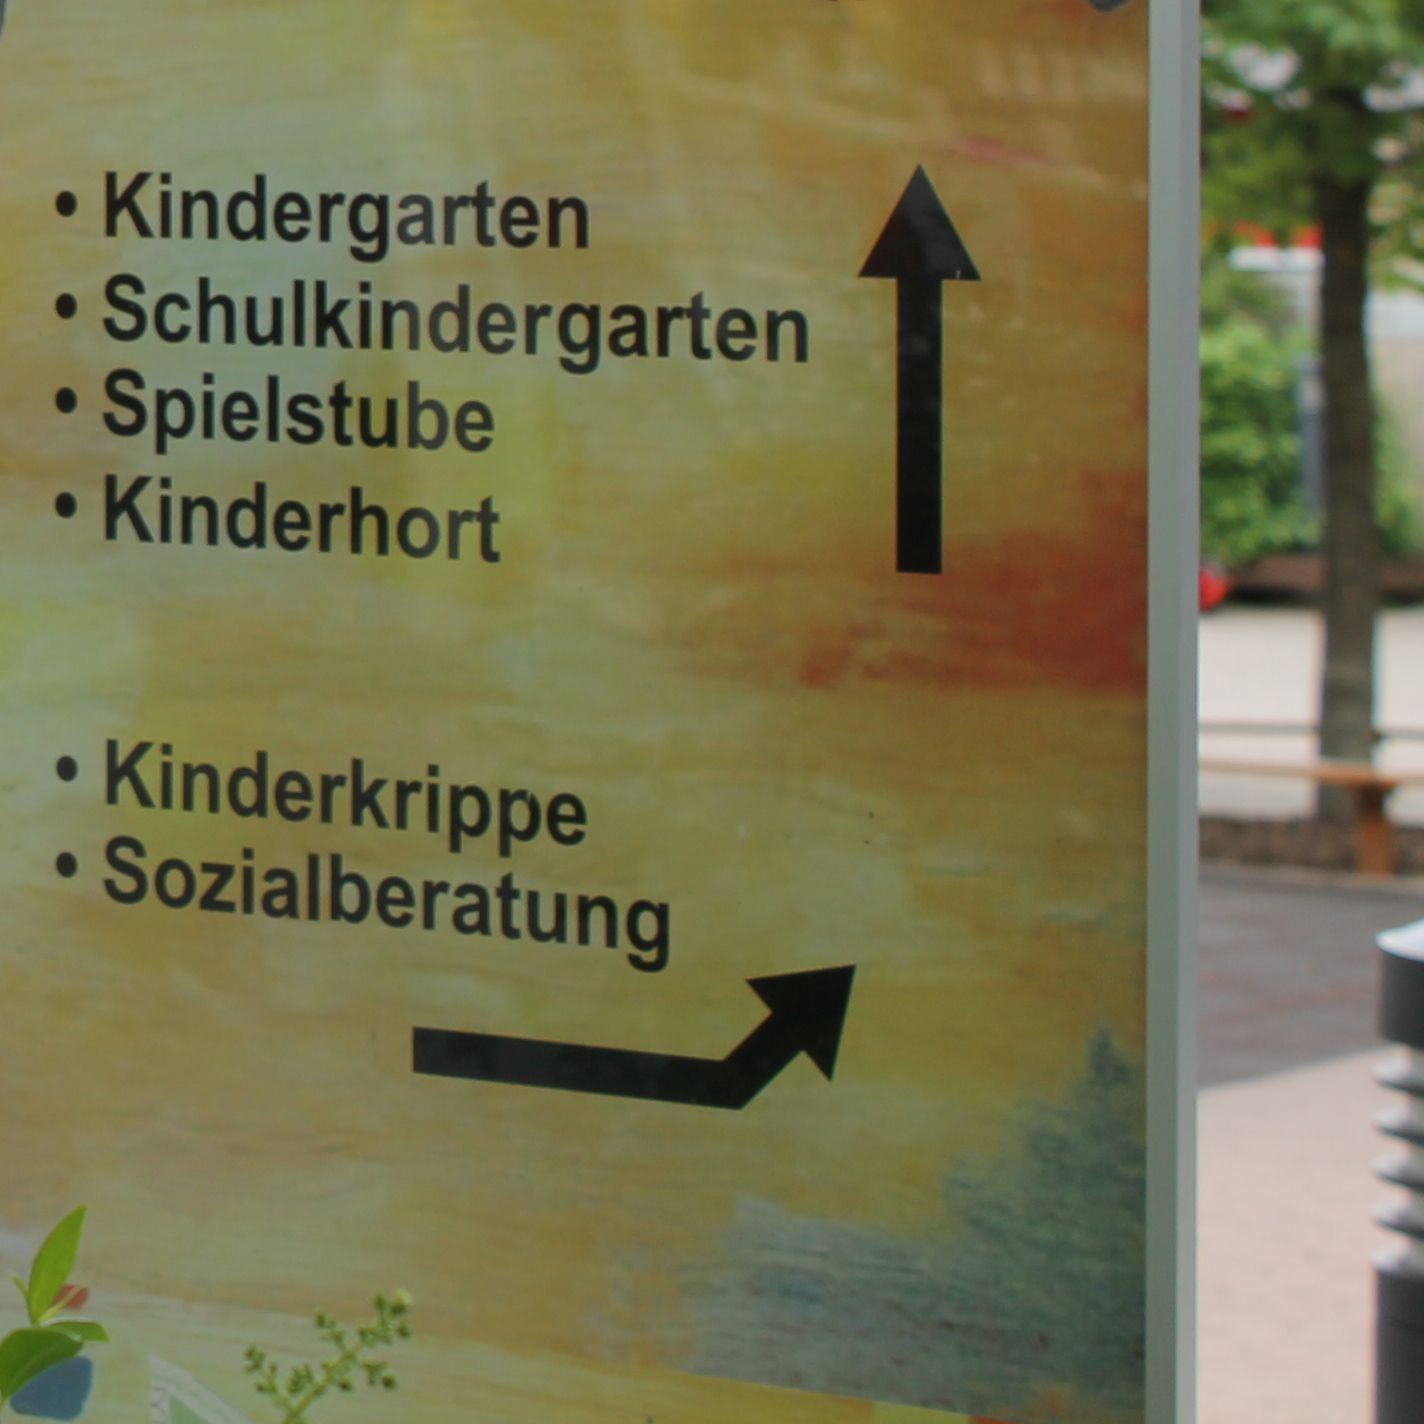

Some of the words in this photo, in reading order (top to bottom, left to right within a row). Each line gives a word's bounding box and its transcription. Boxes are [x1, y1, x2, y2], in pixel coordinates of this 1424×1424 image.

[104, 170, 590, 262] Kindergarten
[103, 273, 809, 375] Schulkindergarten
[103, 369, 495, 454] Spielstube
[104, 473, 501, 563] Kinderhort
[105, 738, 588, 858] Kinderkrippe
[103, 835, 671, 973] Sozialberatung
